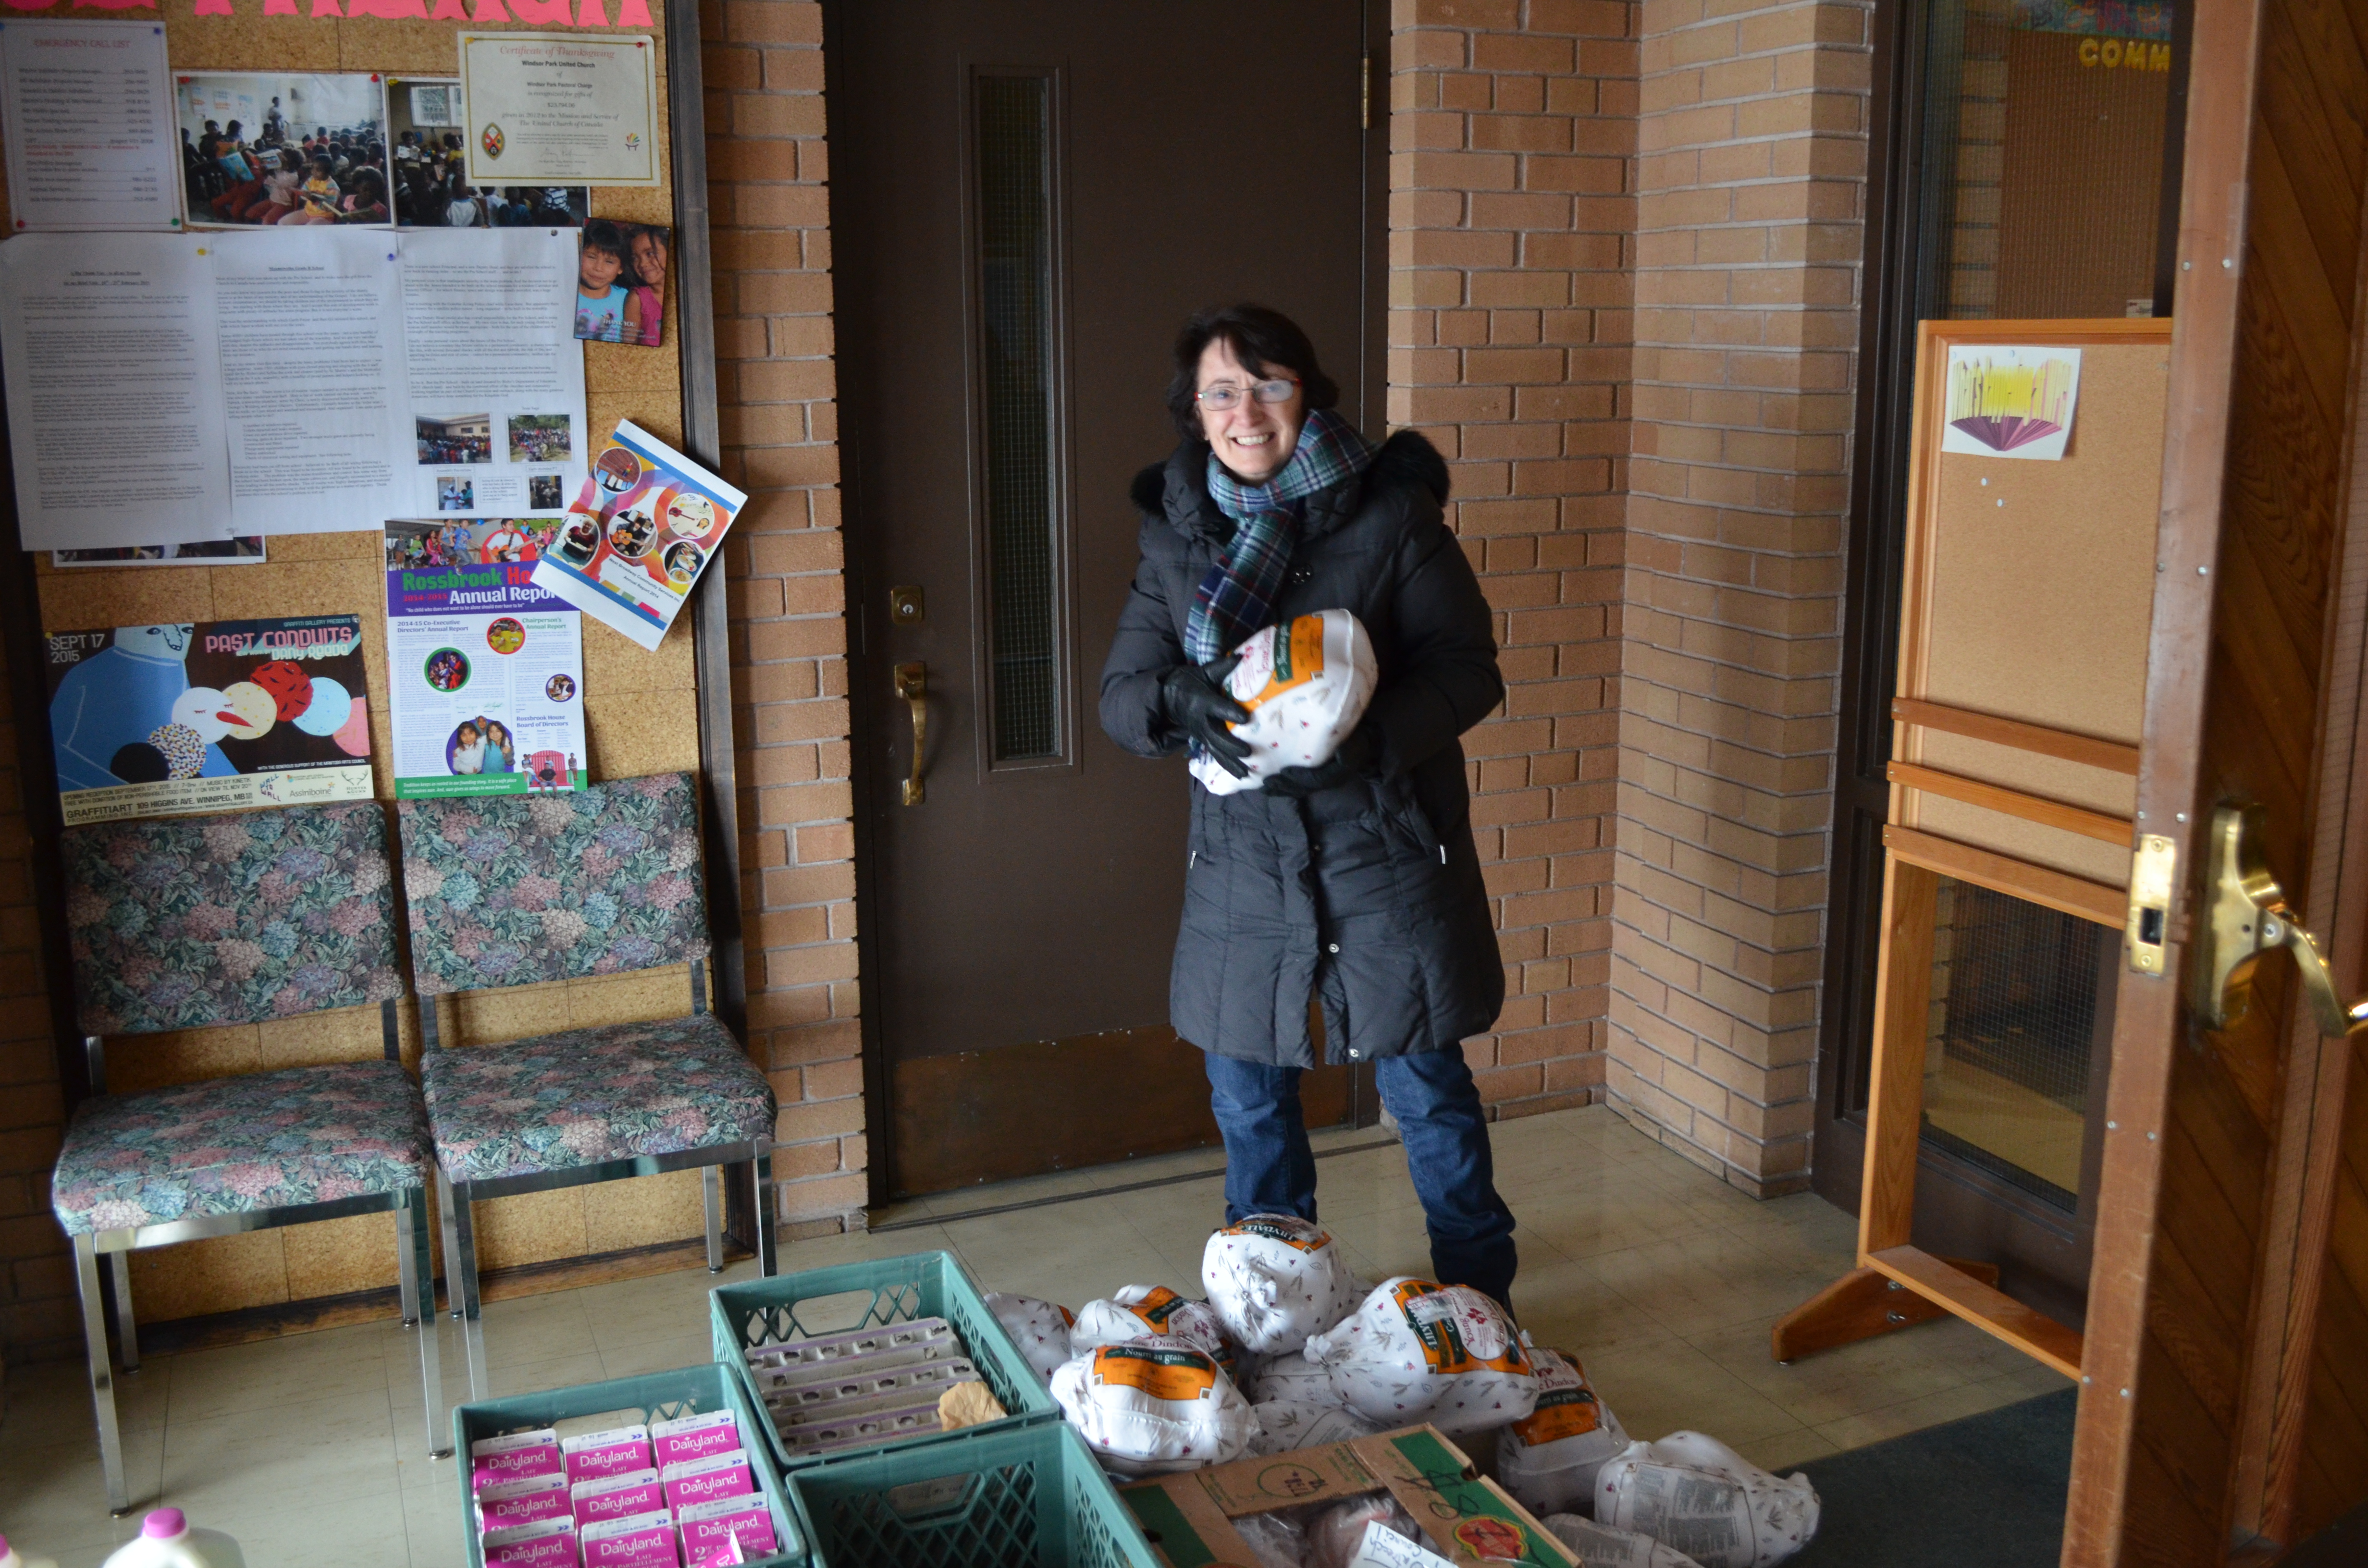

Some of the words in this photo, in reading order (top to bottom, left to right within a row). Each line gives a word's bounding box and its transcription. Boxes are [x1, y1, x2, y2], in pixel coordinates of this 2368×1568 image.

[89, 39, 110, 48] CALL
[112, 40, 130, 48] LIST
[500, 46, 541, 58] Certificate
[546, 47, 554, 57] of
[557, 47, 615, 59] Thanksgiving
[402, 568, 502, 591] Rossbrook
[609, 558, 618, 566] West
[618, 563, 637, 576] Broadway
[637, 575, 658, 590] Community
[624, 576, 637, 586] Annual
[637, 583, 650, 593] Report
[449, 586, 507, 605] Annual
[510, 587, 555, 603] Repor
[305, 618, 326, 626] GALLERY
[49, 635, 87, 650] SEPT
[90, 633, 105, 648] 17
[205, 632, 255, 653] PAST
[262, 626, 352, 650] CONDUITS
[51, 649, 81, 663] 2015
[260, 774, 280, 789] WALL
[260, 788, 282, 802] WALL
[289, 787, 332, 798] Assiniboine
[66, 803, 133, 819] GRAFFITIART
[136, 801, 149, 810] 109
[150, 798, 178, 808] HIGGINS
[180, 797, 196, 806] AVE.
[196, 794, 233, 804] WINNIPEG,
[1459, 1317, 1475, 1347] Young
[1152, 1339, 1193, 1349] Dindon
[1125, 1348, 1152, 1358] Nourri
[1164, 1353, 1186, 1365] grain
[1543, 1378, 1578, 1389] Dindon
[669, 1430, 726, 1452] Dairyland
[489, 1449, 546, 1470] Dairyland
[580, 1446, 637, 1468] Dairyland
[680, 1472, 738, 1494] Dairyland
[496, 1494, 556, 1517] Dairyland
[588, 1490, 648, 1512] Dairyland
[698, 1514, 758, 1537] Dairyland
[501, 1539, 563, 1563] Dairyland
[600, 1532, 662, 1556] Dairyland
[1375, 1525, 1422, 1557] Council
